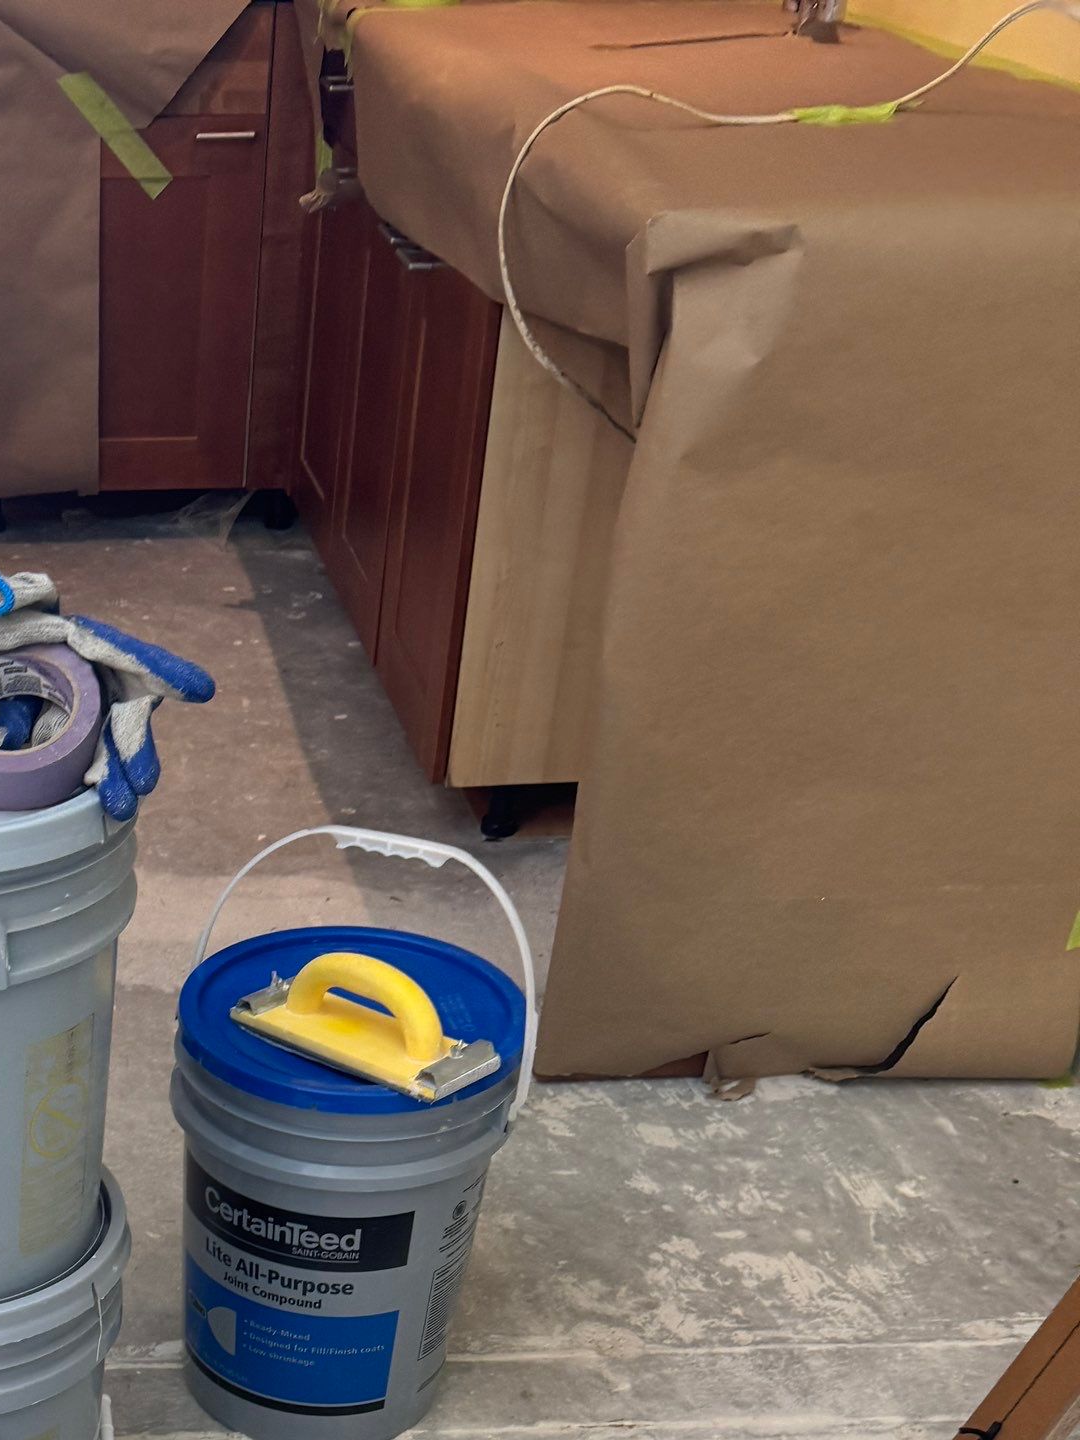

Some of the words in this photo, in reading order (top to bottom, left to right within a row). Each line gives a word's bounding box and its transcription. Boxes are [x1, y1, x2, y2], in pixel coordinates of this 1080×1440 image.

[205, 1186, 362, 1252] CertainTeed
[206, 1236, 232, 1267] Lite
[235, 1257, 354, 1297] All-Purpose
[223, 1271, 249, 1292] Joint
[252, 1285, 322, 1310] Compound
[248, 1345, 266, 1358] Low
[249, 1332, 291, 1352] Designed
[293, 1343, 309, 1354] for
[360, 1343, 385, 1354] coats
